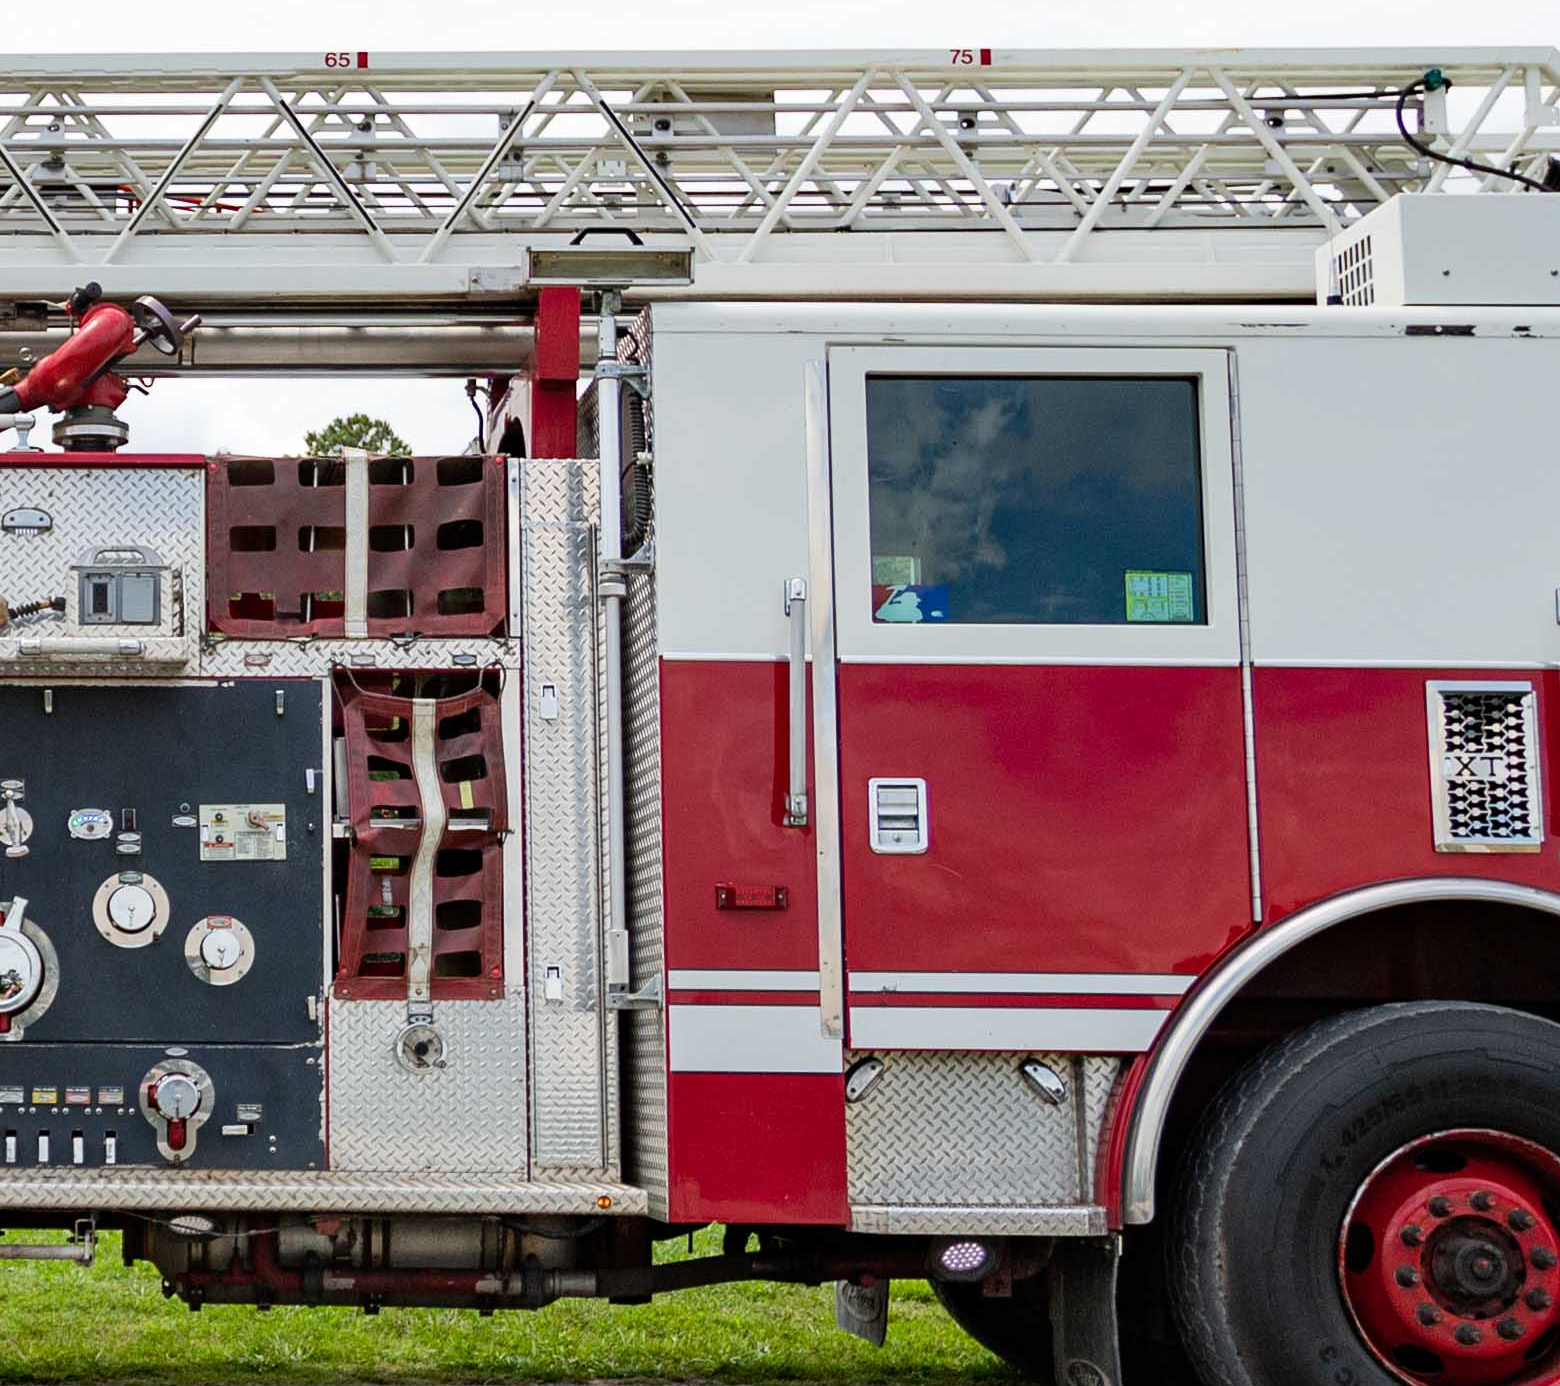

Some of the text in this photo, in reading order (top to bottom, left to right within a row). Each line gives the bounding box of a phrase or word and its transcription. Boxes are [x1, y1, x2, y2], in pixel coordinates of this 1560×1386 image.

[325, 52, 351, 68] 65
[949, 48, 974, 65] 75
[1454, 756, 1504, 777] XT
